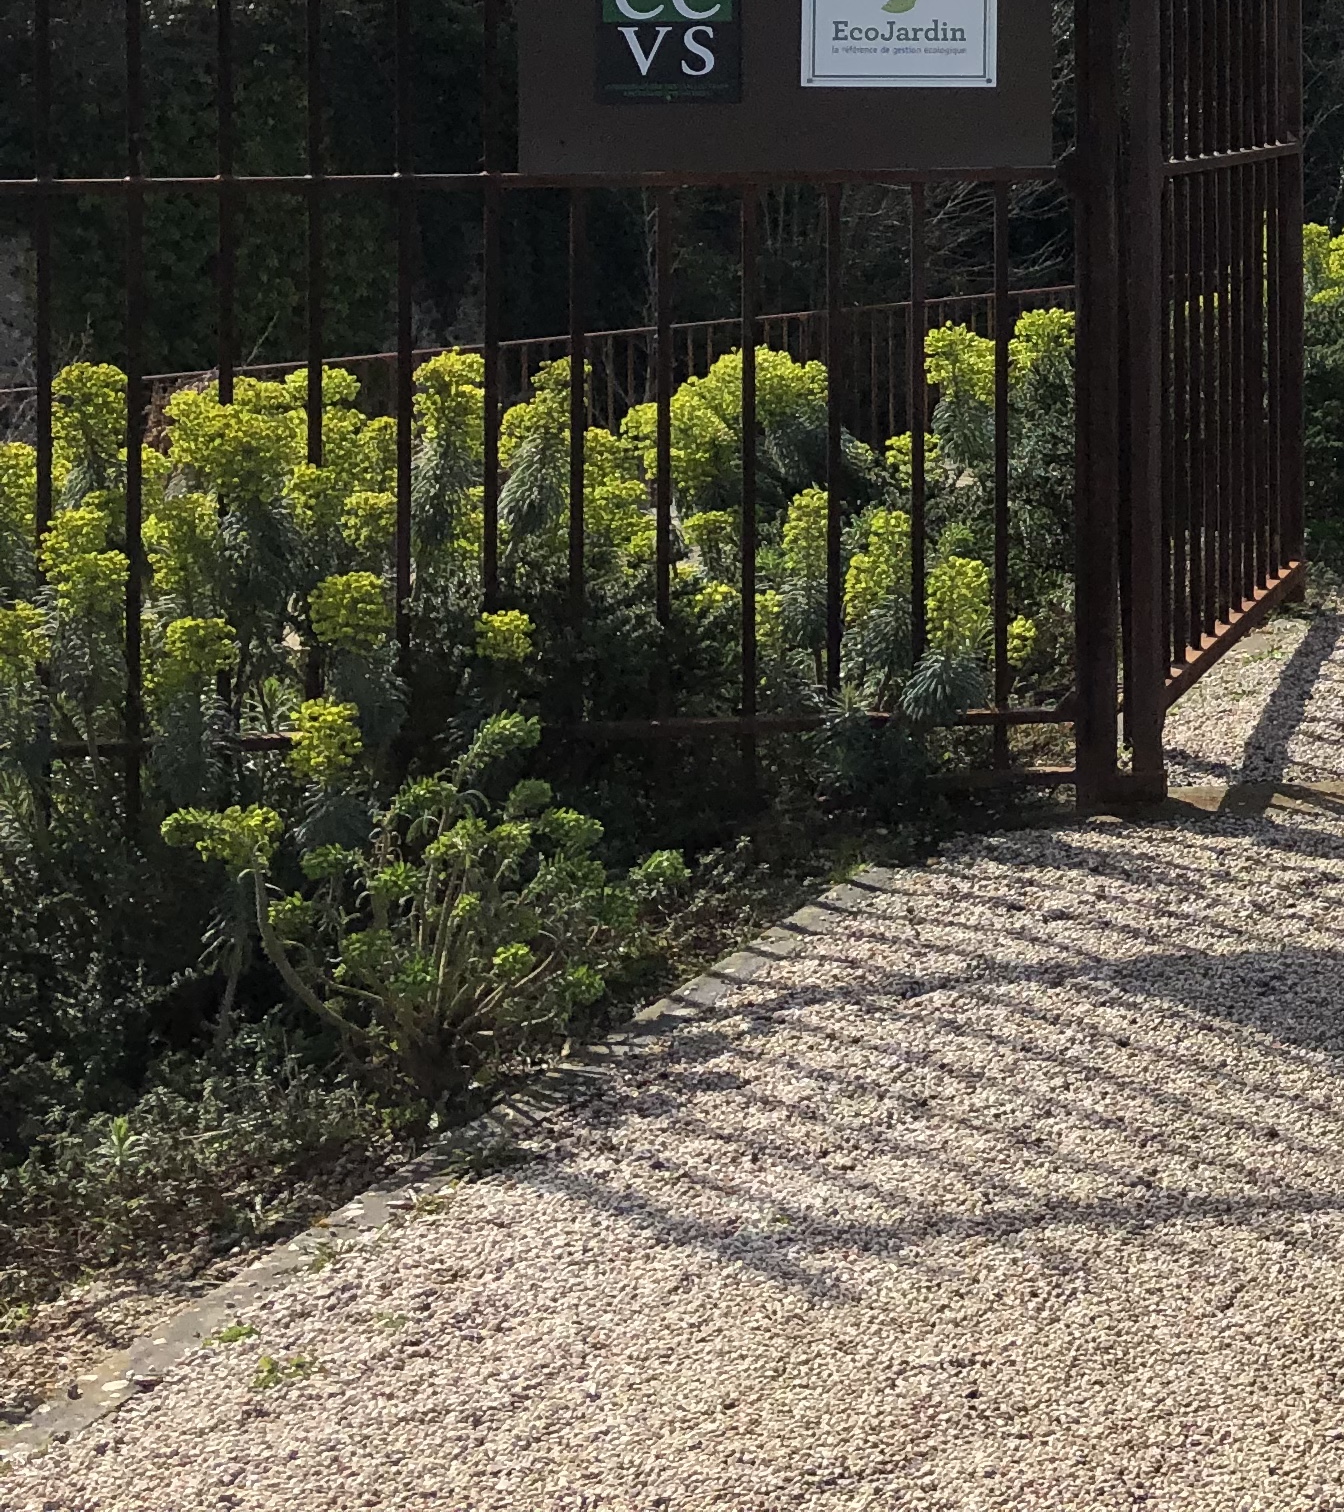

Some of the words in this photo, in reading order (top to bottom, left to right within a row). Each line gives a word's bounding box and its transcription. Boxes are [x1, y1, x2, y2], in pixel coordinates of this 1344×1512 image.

[832, 19, 967, 42] EcoJardin
[617, 25, 715, 76] VS
[881, 45, 890, 54] de
